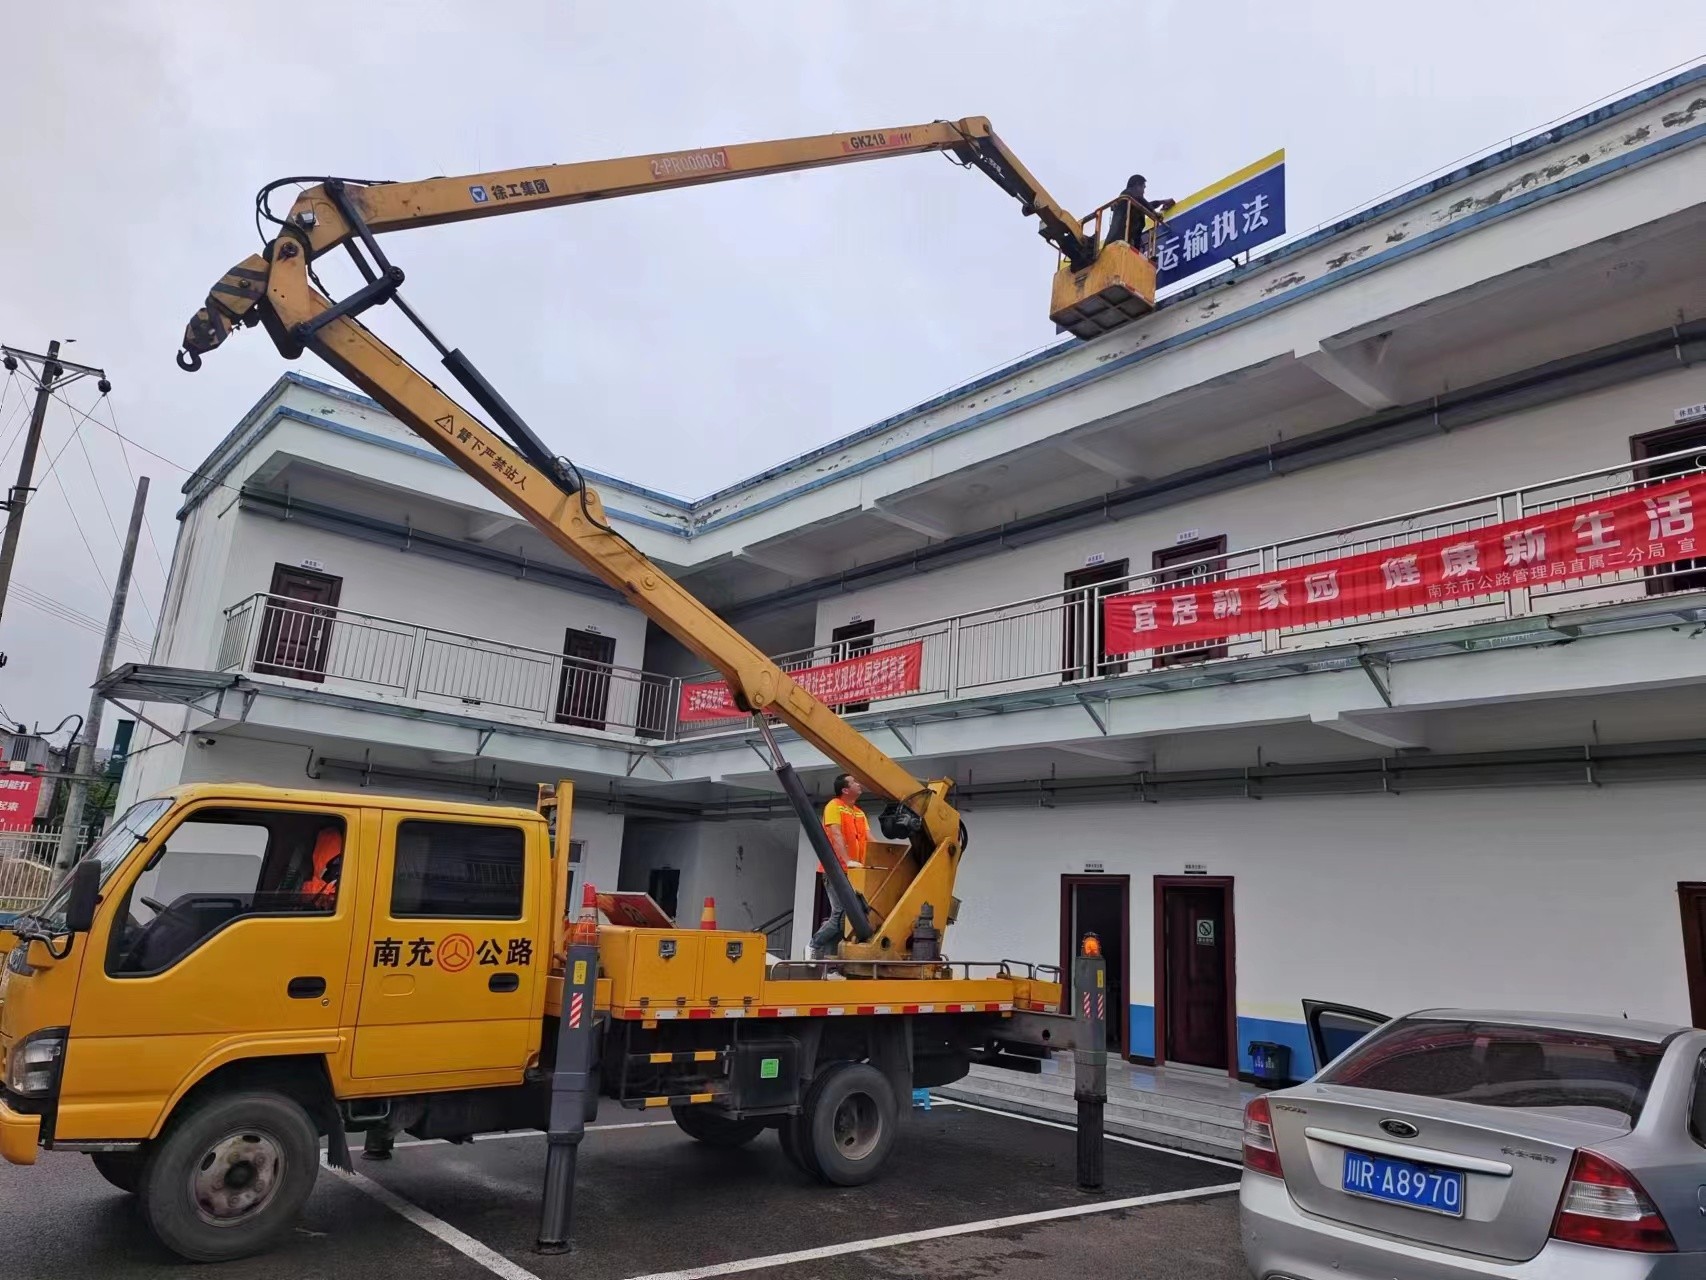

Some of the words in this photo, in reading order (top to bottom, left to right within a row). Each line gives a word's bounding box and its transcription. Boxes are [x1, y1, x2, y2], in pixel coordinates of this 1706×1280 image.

[850, 133, 886, 149] GKZ18
[491, 178, 550, 201] 徐工集团
[1144, 194, 1269, 274] 运输执法
[1131, 568, 1340, 634] 宜居靓家园
[1381, 490, 1694, 591] 健康新生活
[1427, 542, 1666, 600] 南充市公路管理局直属二分局
[1677, 537, 1698, 554] 宣
[372, 937, 435, 967] 南充
[476, 937, 533, 967] 公路
